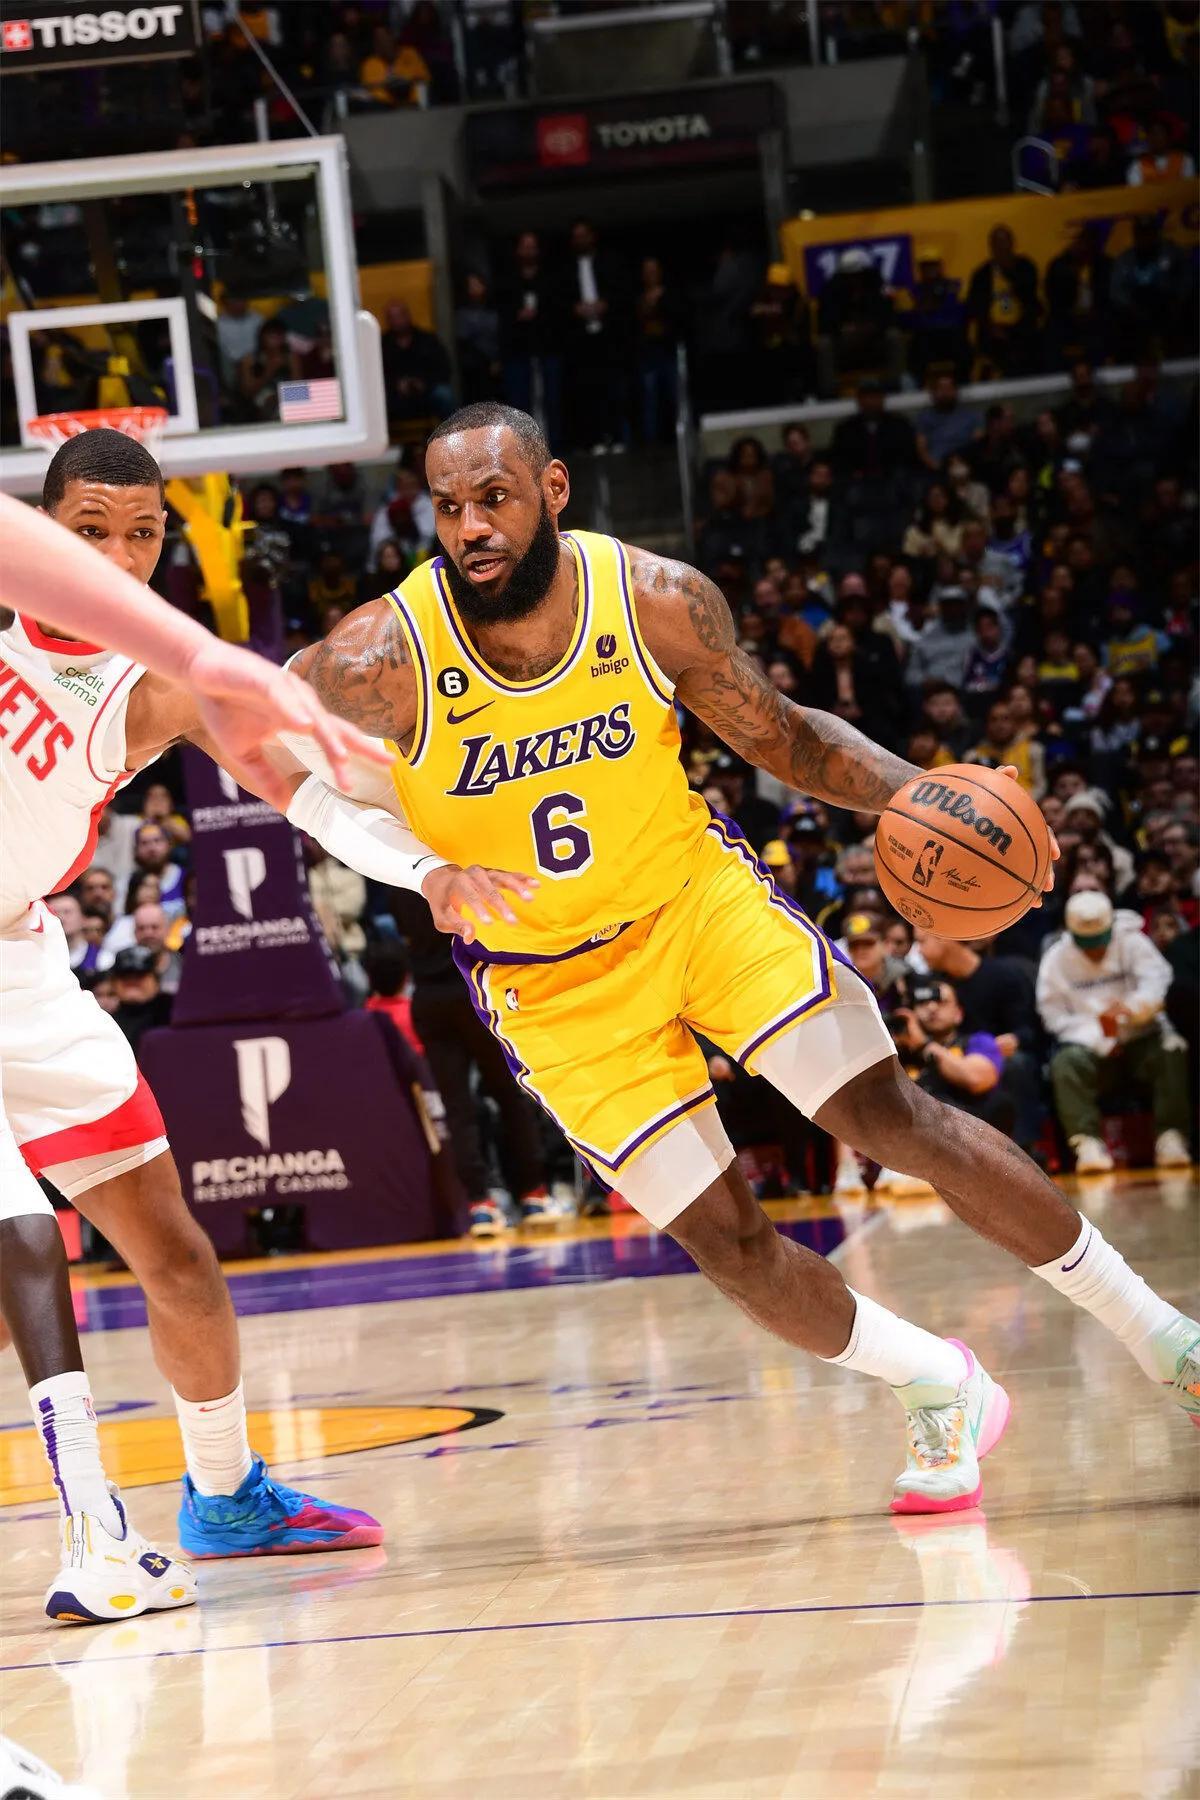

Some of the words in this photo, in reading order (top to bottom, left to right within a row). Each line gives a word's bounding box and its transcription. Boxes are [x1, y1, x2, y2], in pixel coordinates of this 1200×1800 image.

[31, 5, 184, 48] TISSOT
[597, 114, 711, 148] TOYOTA
[65, 666, 105, 694] credit
[591, 657, 630, 679] bibigo
[53, 672, 98, 707] karma
[445, 702, 636, 797] LAKERS
[529, 789, 595, 881] 6
[911, 781, 1013, 857] Wilson
[195, 915, 309, 943] PECHANGA
[191, 1149, 346, 1186] PECHANGA
[193, 1177, 267, 1203] RESORT
[274, 1172, 349, 1195] CASINO
